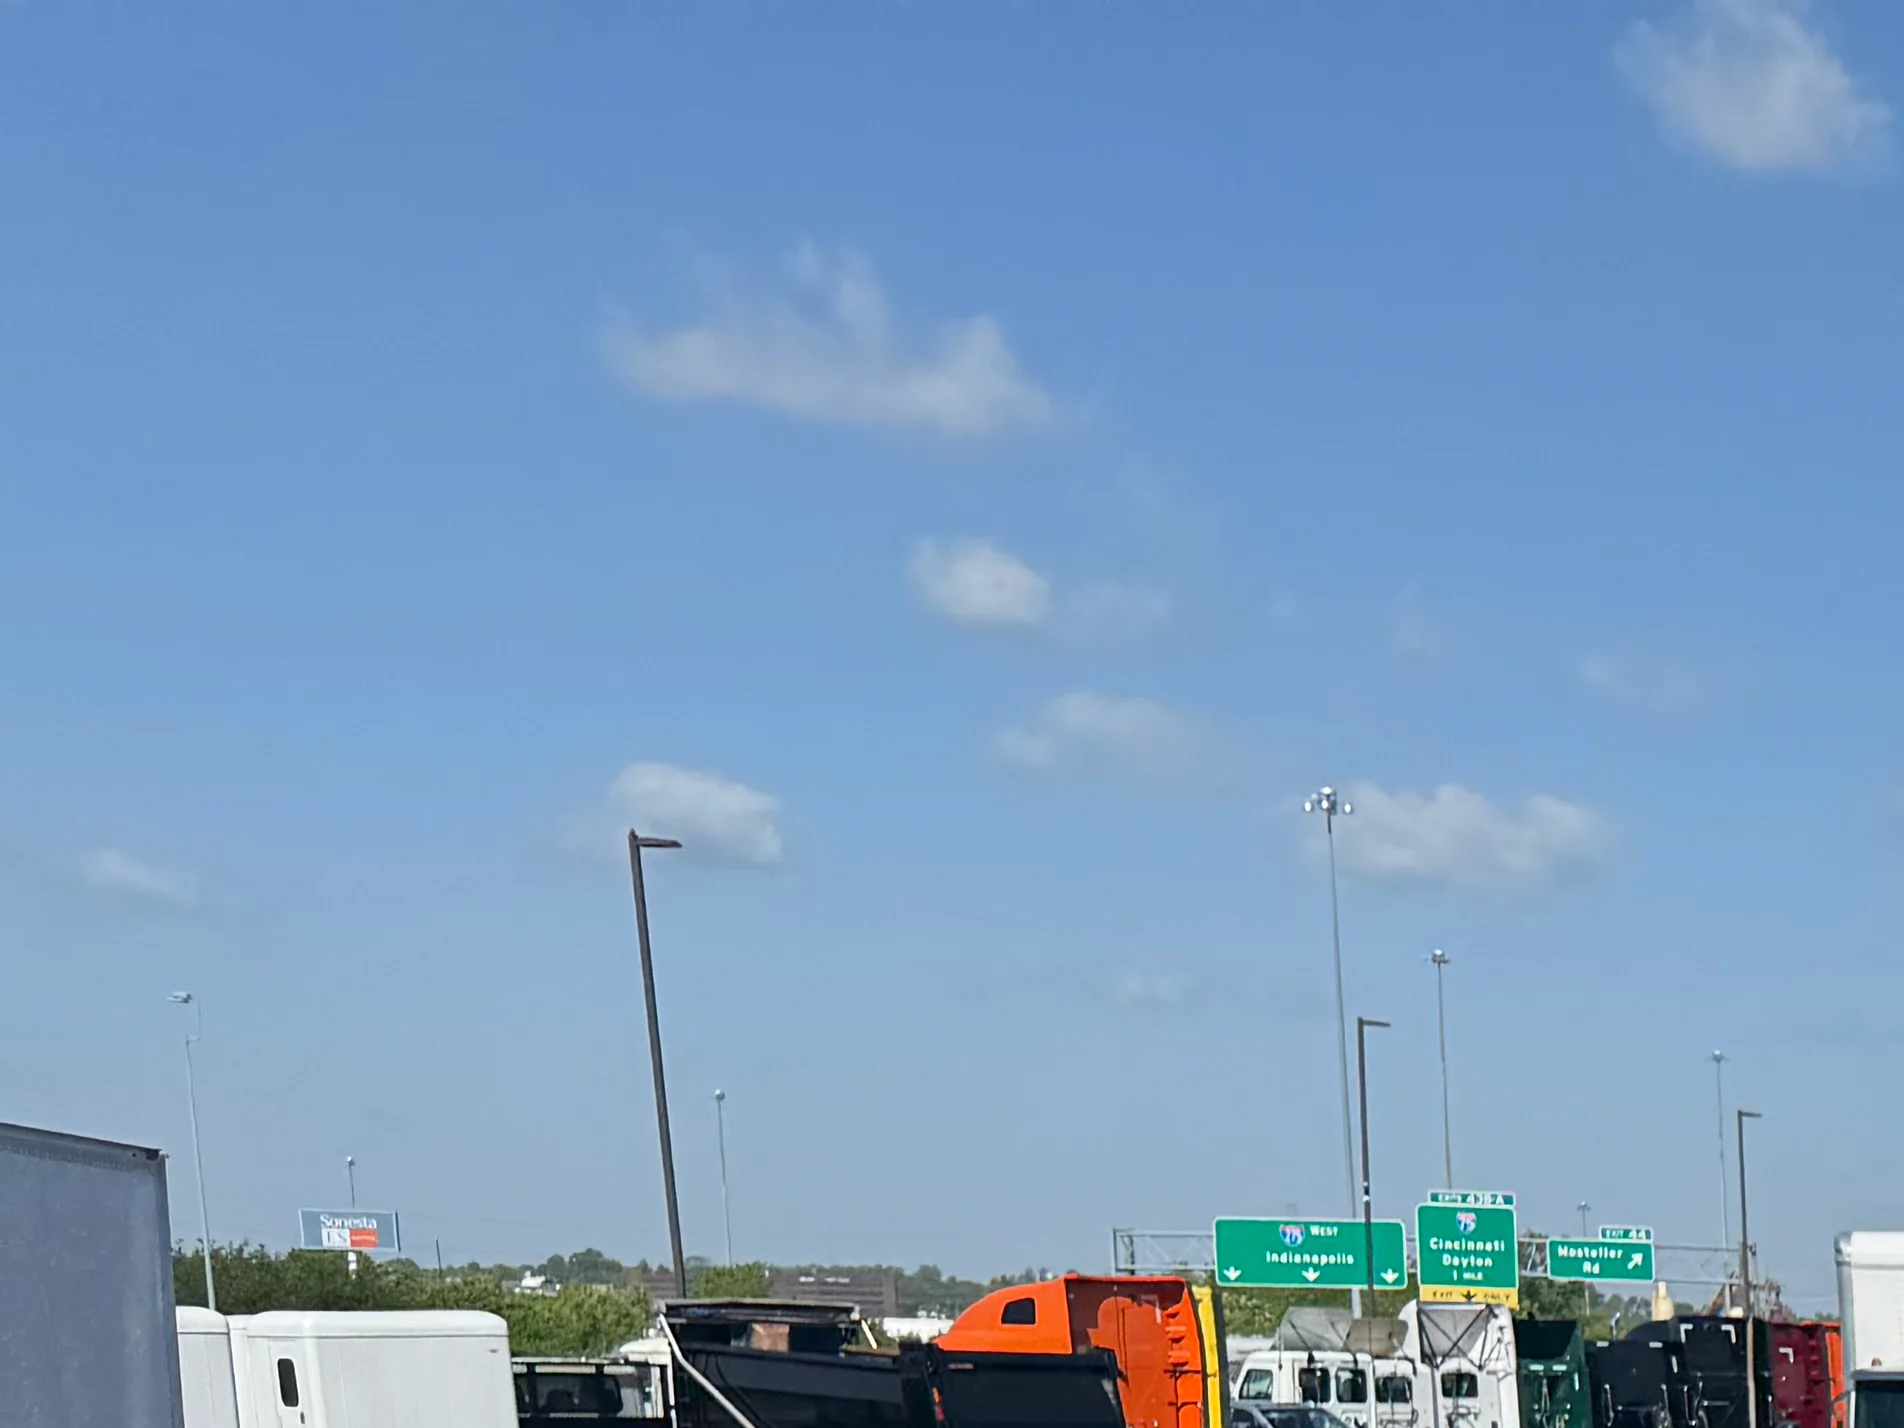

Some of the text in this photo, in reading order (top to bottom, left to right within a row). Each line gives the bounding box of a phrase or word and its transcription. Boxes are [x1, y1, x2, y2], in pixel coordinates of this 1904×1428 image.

[1309, 1225, 1339, 1237] WEST
[1429, 1236, 1505, 1252] Cincinnati
[1557, 1244, 1623, 1259] Mosteller
[1266, 1250, 1354, 1266] Indianapolis
[1442, 1253, 1493, 1269] Dayton
[1582, 1260, 1600, 1274] Rd
